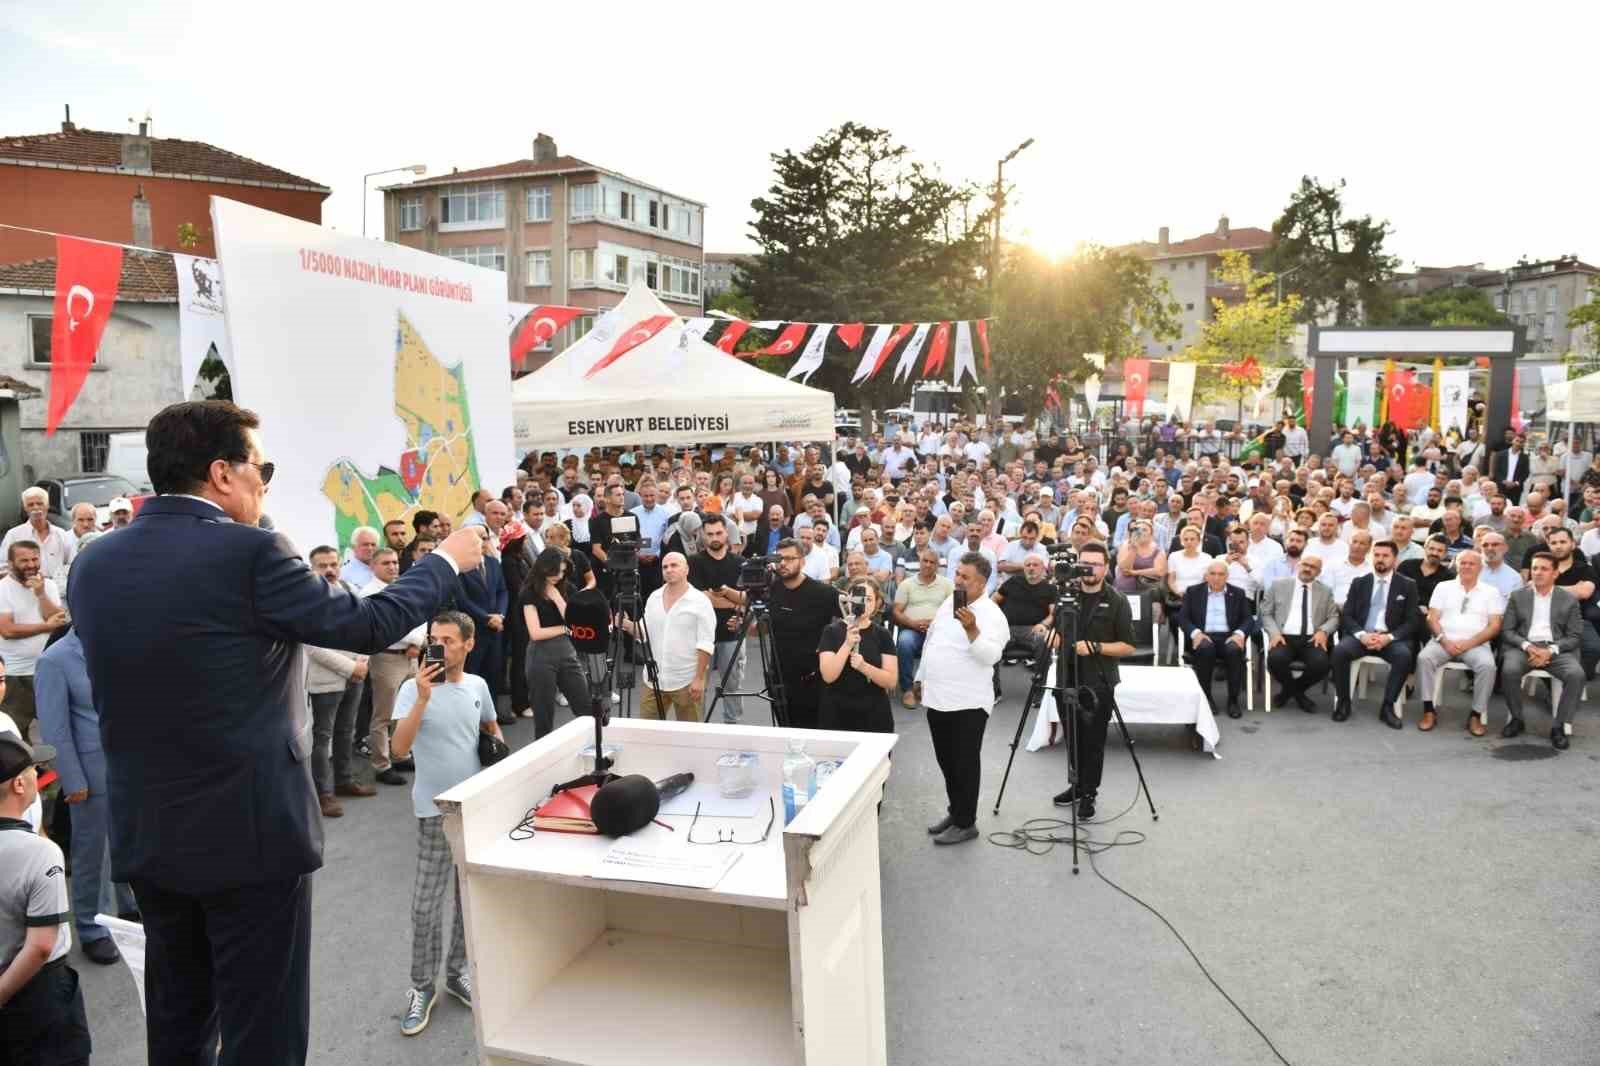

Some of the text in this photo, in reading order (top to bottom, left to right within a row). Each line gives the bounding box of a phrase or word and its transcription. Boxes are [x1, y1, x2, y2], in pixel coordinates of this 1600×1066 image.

[299, 248, 342, 275] 1/5000
[378, 262, 401, 289] İMAR
[402, 271, 428, 294] PLANI
[568, 413, 729, 436] ESENYURT BELEDİYESİ
